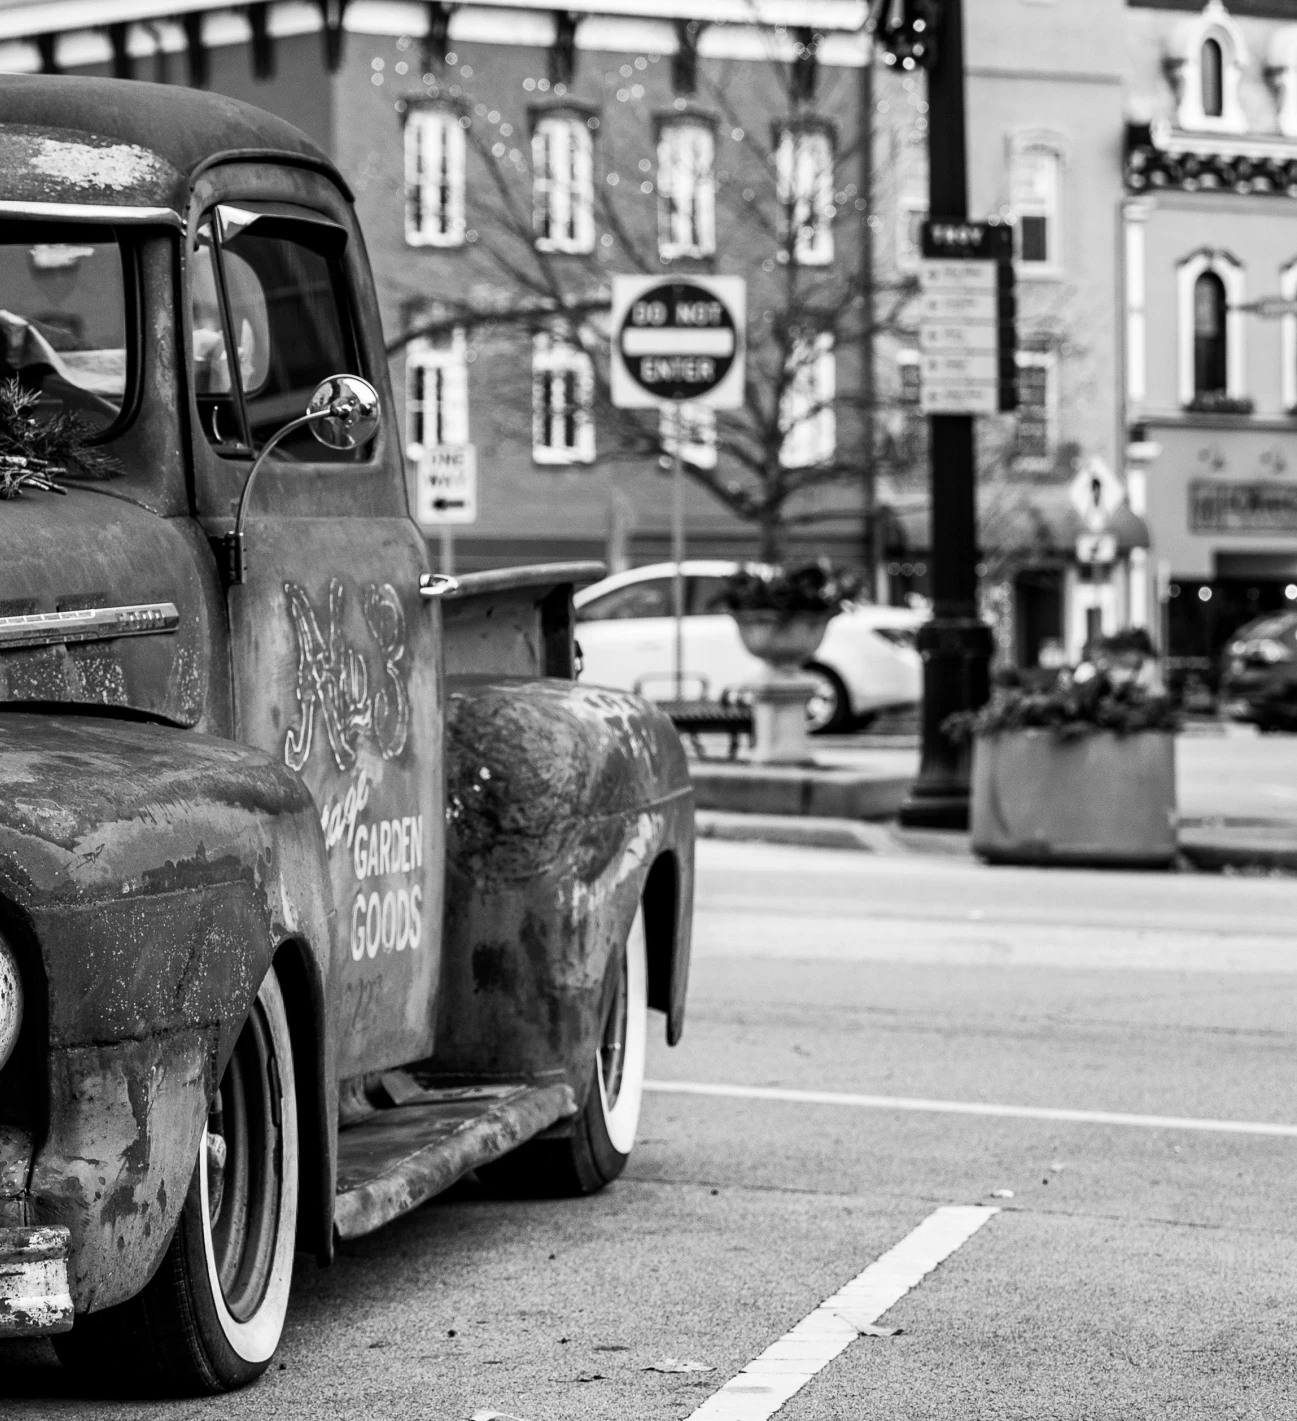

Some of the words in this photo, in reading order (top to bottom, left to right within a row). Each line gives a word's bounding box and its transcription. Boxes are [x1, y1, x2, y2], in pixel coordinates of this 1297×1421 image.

[632, 300, 668, 326] DO
[675, 300, 722, 326] NOT
[640, 358, 716, 383] ENTER
[354, 814, 423, 880] GARDEN
[351, 883, 422, 961] GOODS
